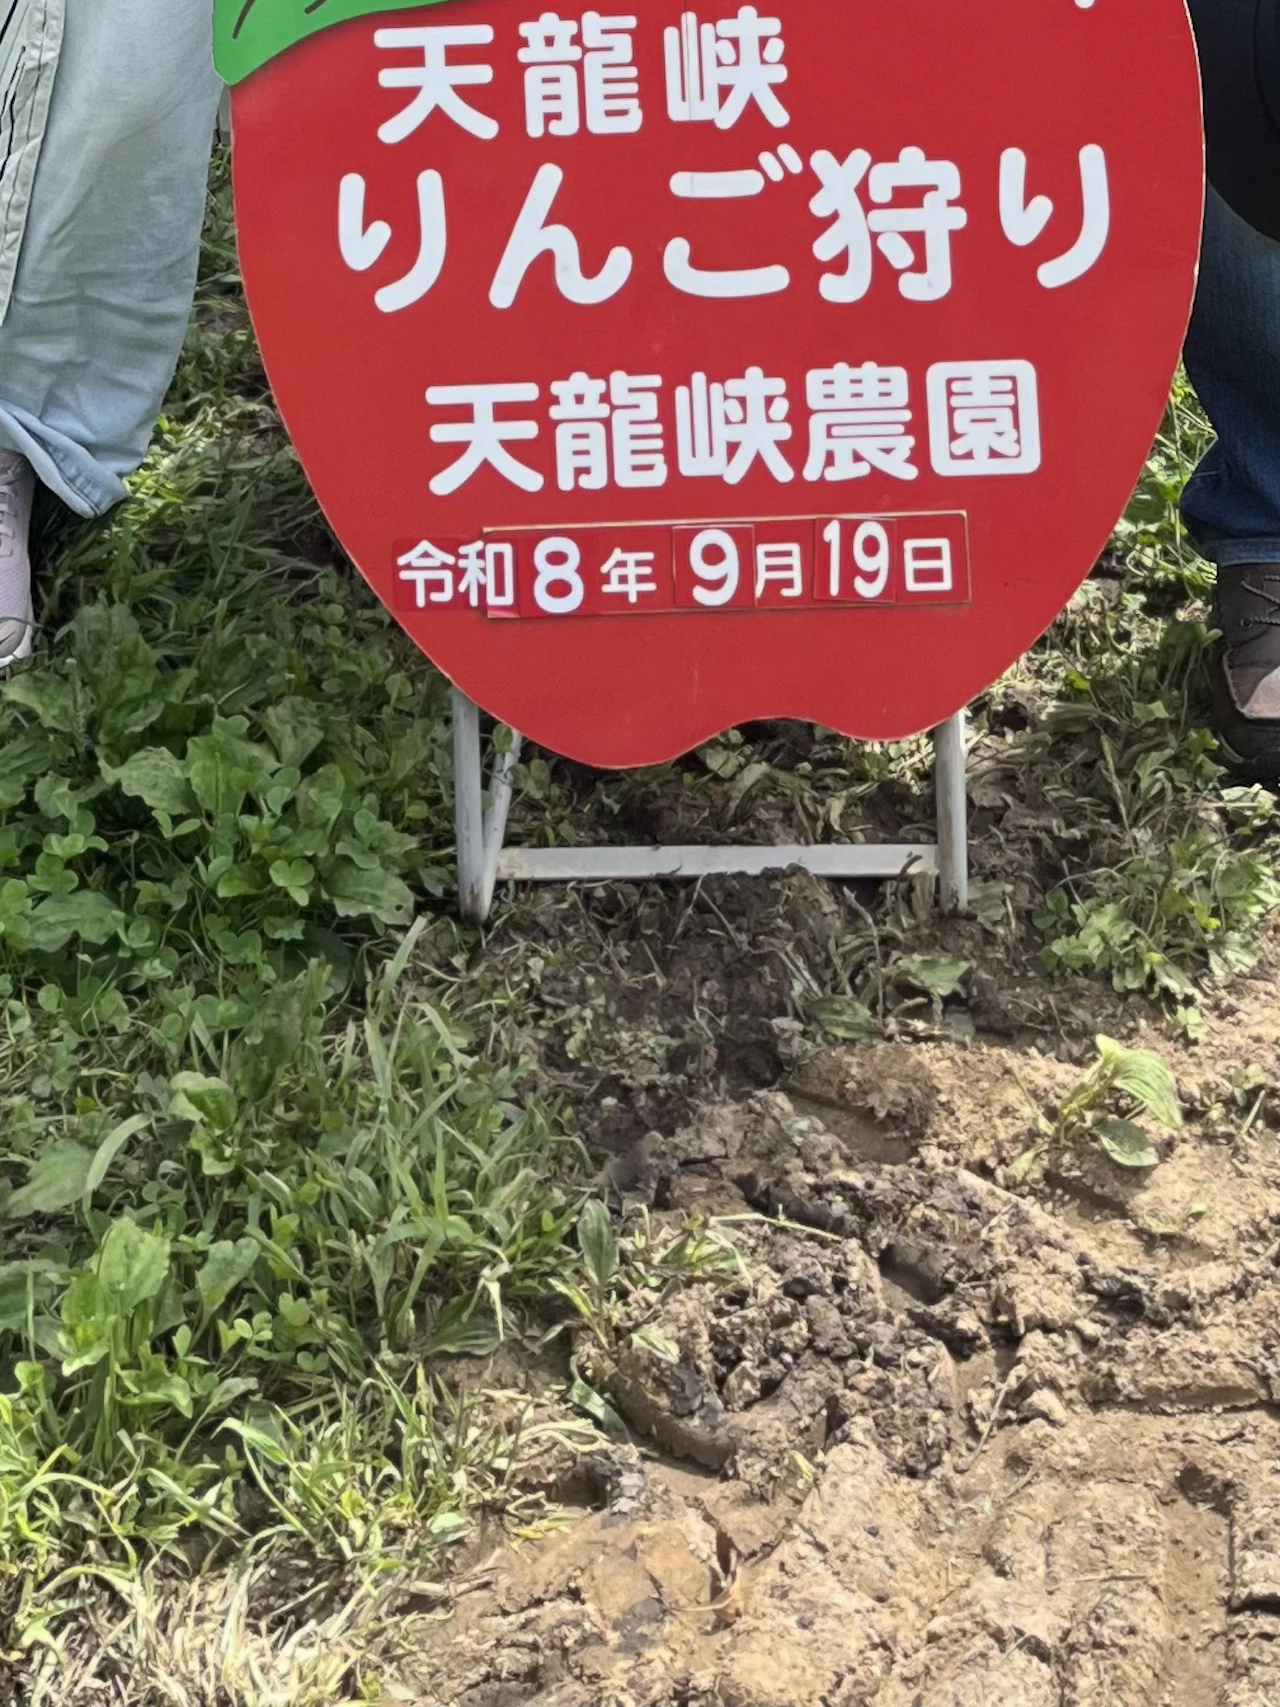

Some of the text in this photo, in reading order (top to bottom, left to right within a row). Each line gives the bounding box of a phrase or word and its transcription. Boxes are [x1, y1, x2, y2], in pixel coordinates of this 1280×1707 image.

[373, 5, 791, 145] 天龍峡
[338, 143, 1111, 314] りんご狩り
[425, 359, 1041, 497] 天龍峡農園
